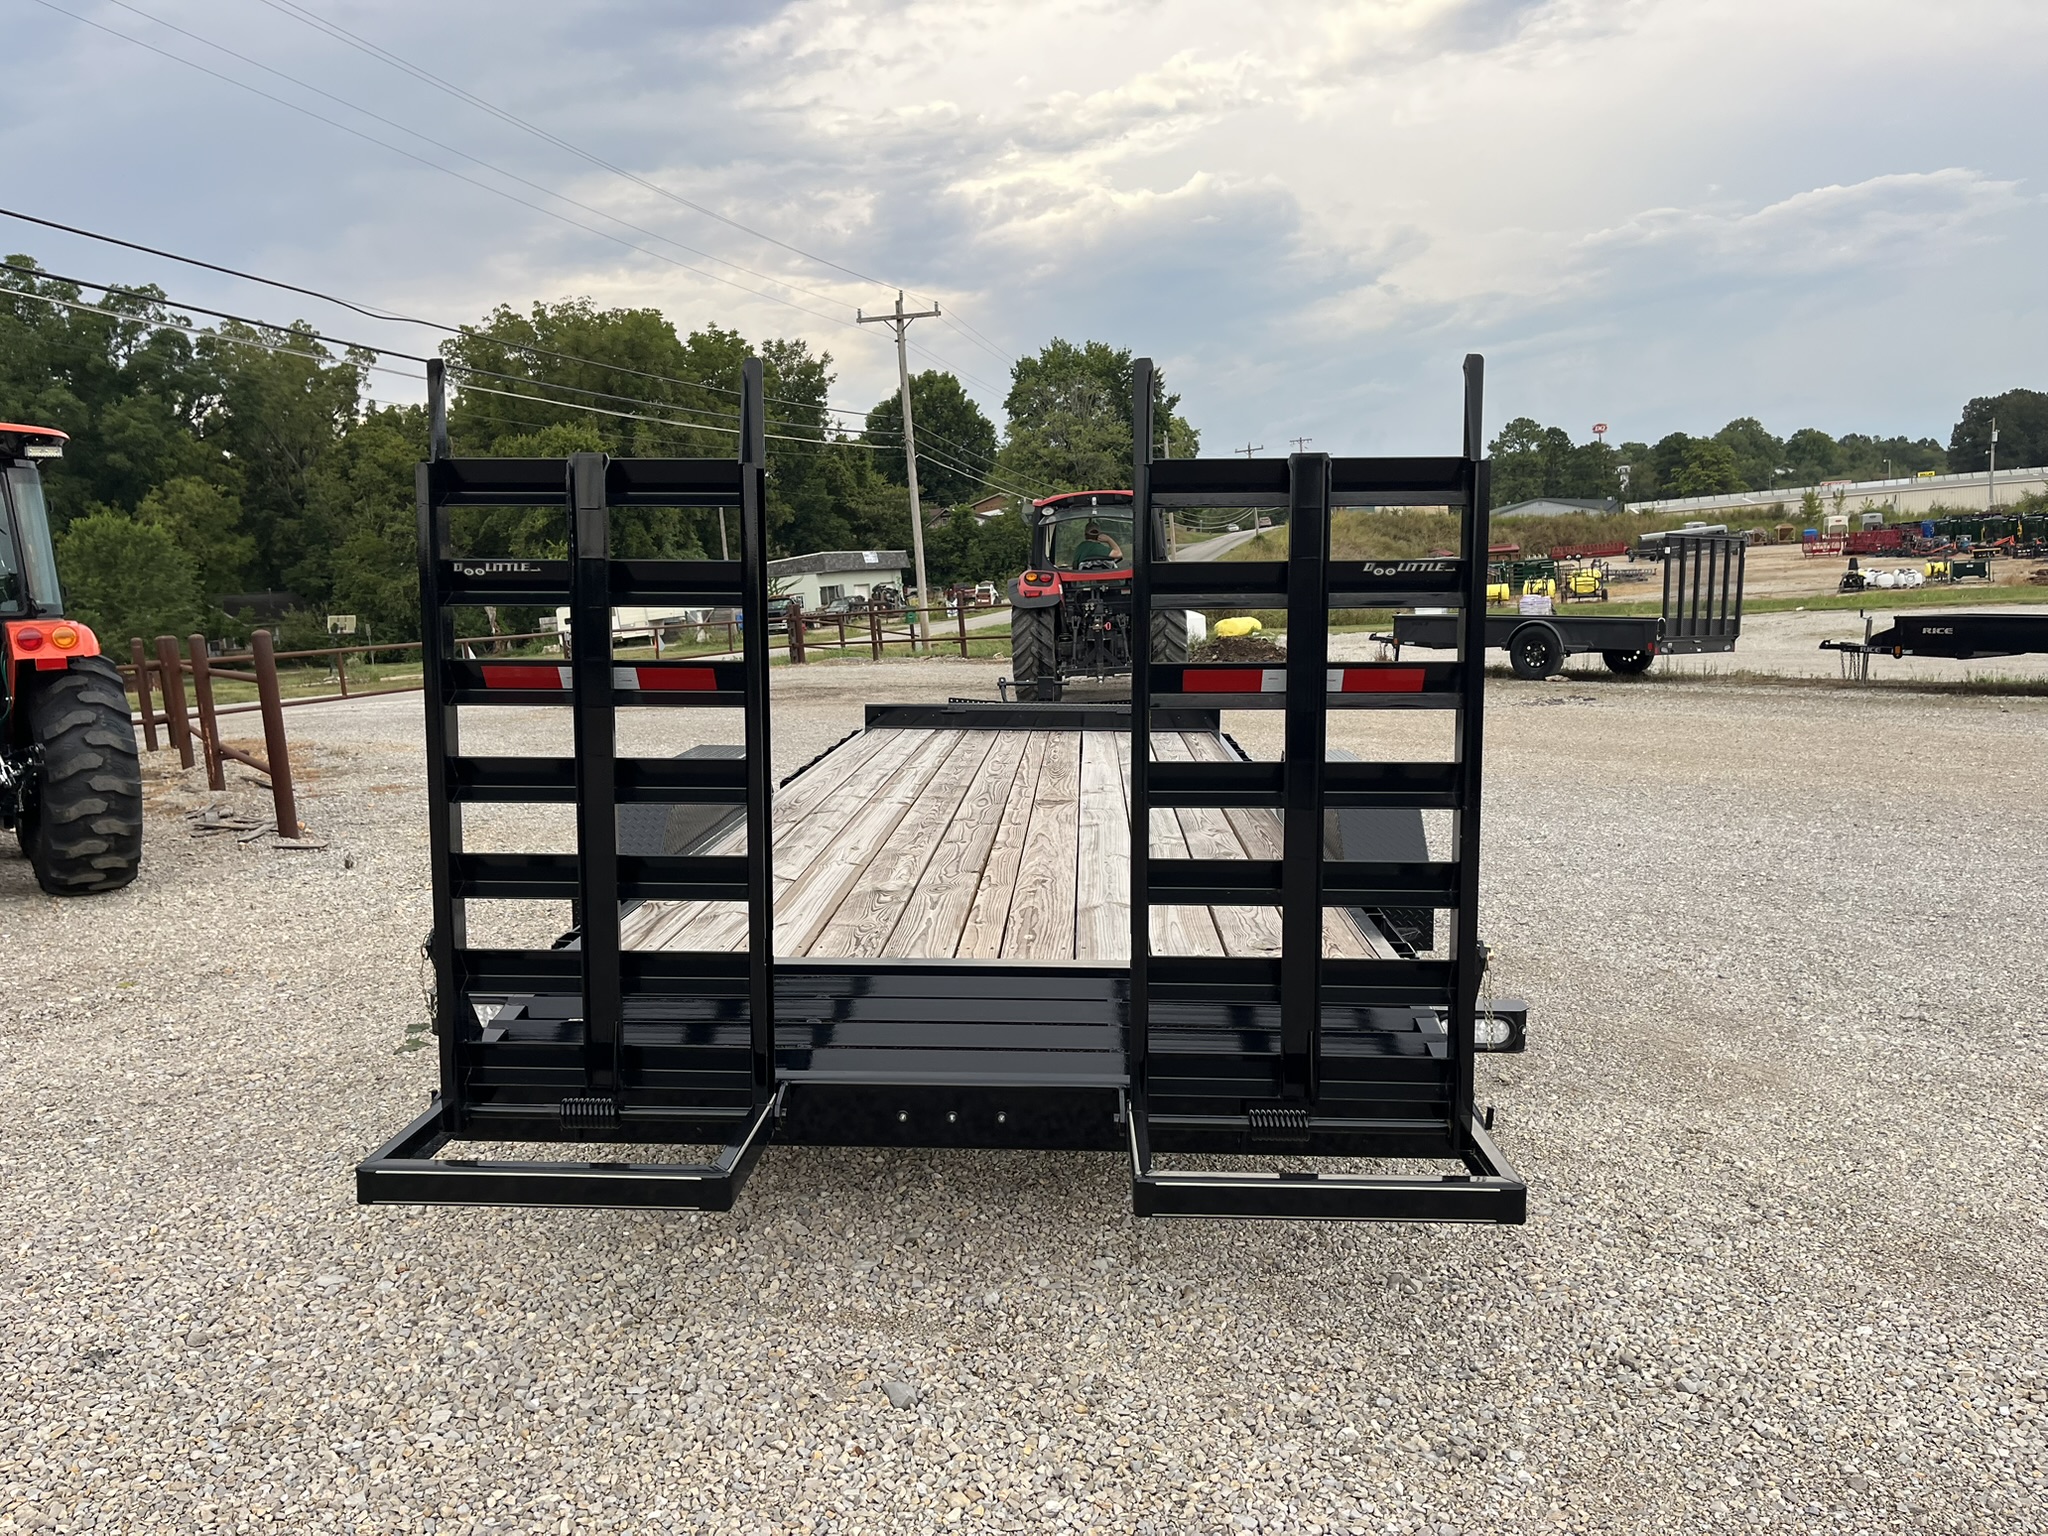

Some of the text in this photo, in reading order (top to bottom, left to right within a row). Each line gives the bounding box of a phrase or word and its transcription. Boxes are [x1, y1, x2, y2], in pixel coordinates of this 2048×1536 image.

[453, 562, 531, 576] DOOLITTLE
[1363, 562, 1446, 576] DOOLITTLE
[1922, 627, 1954, 635] RICE
